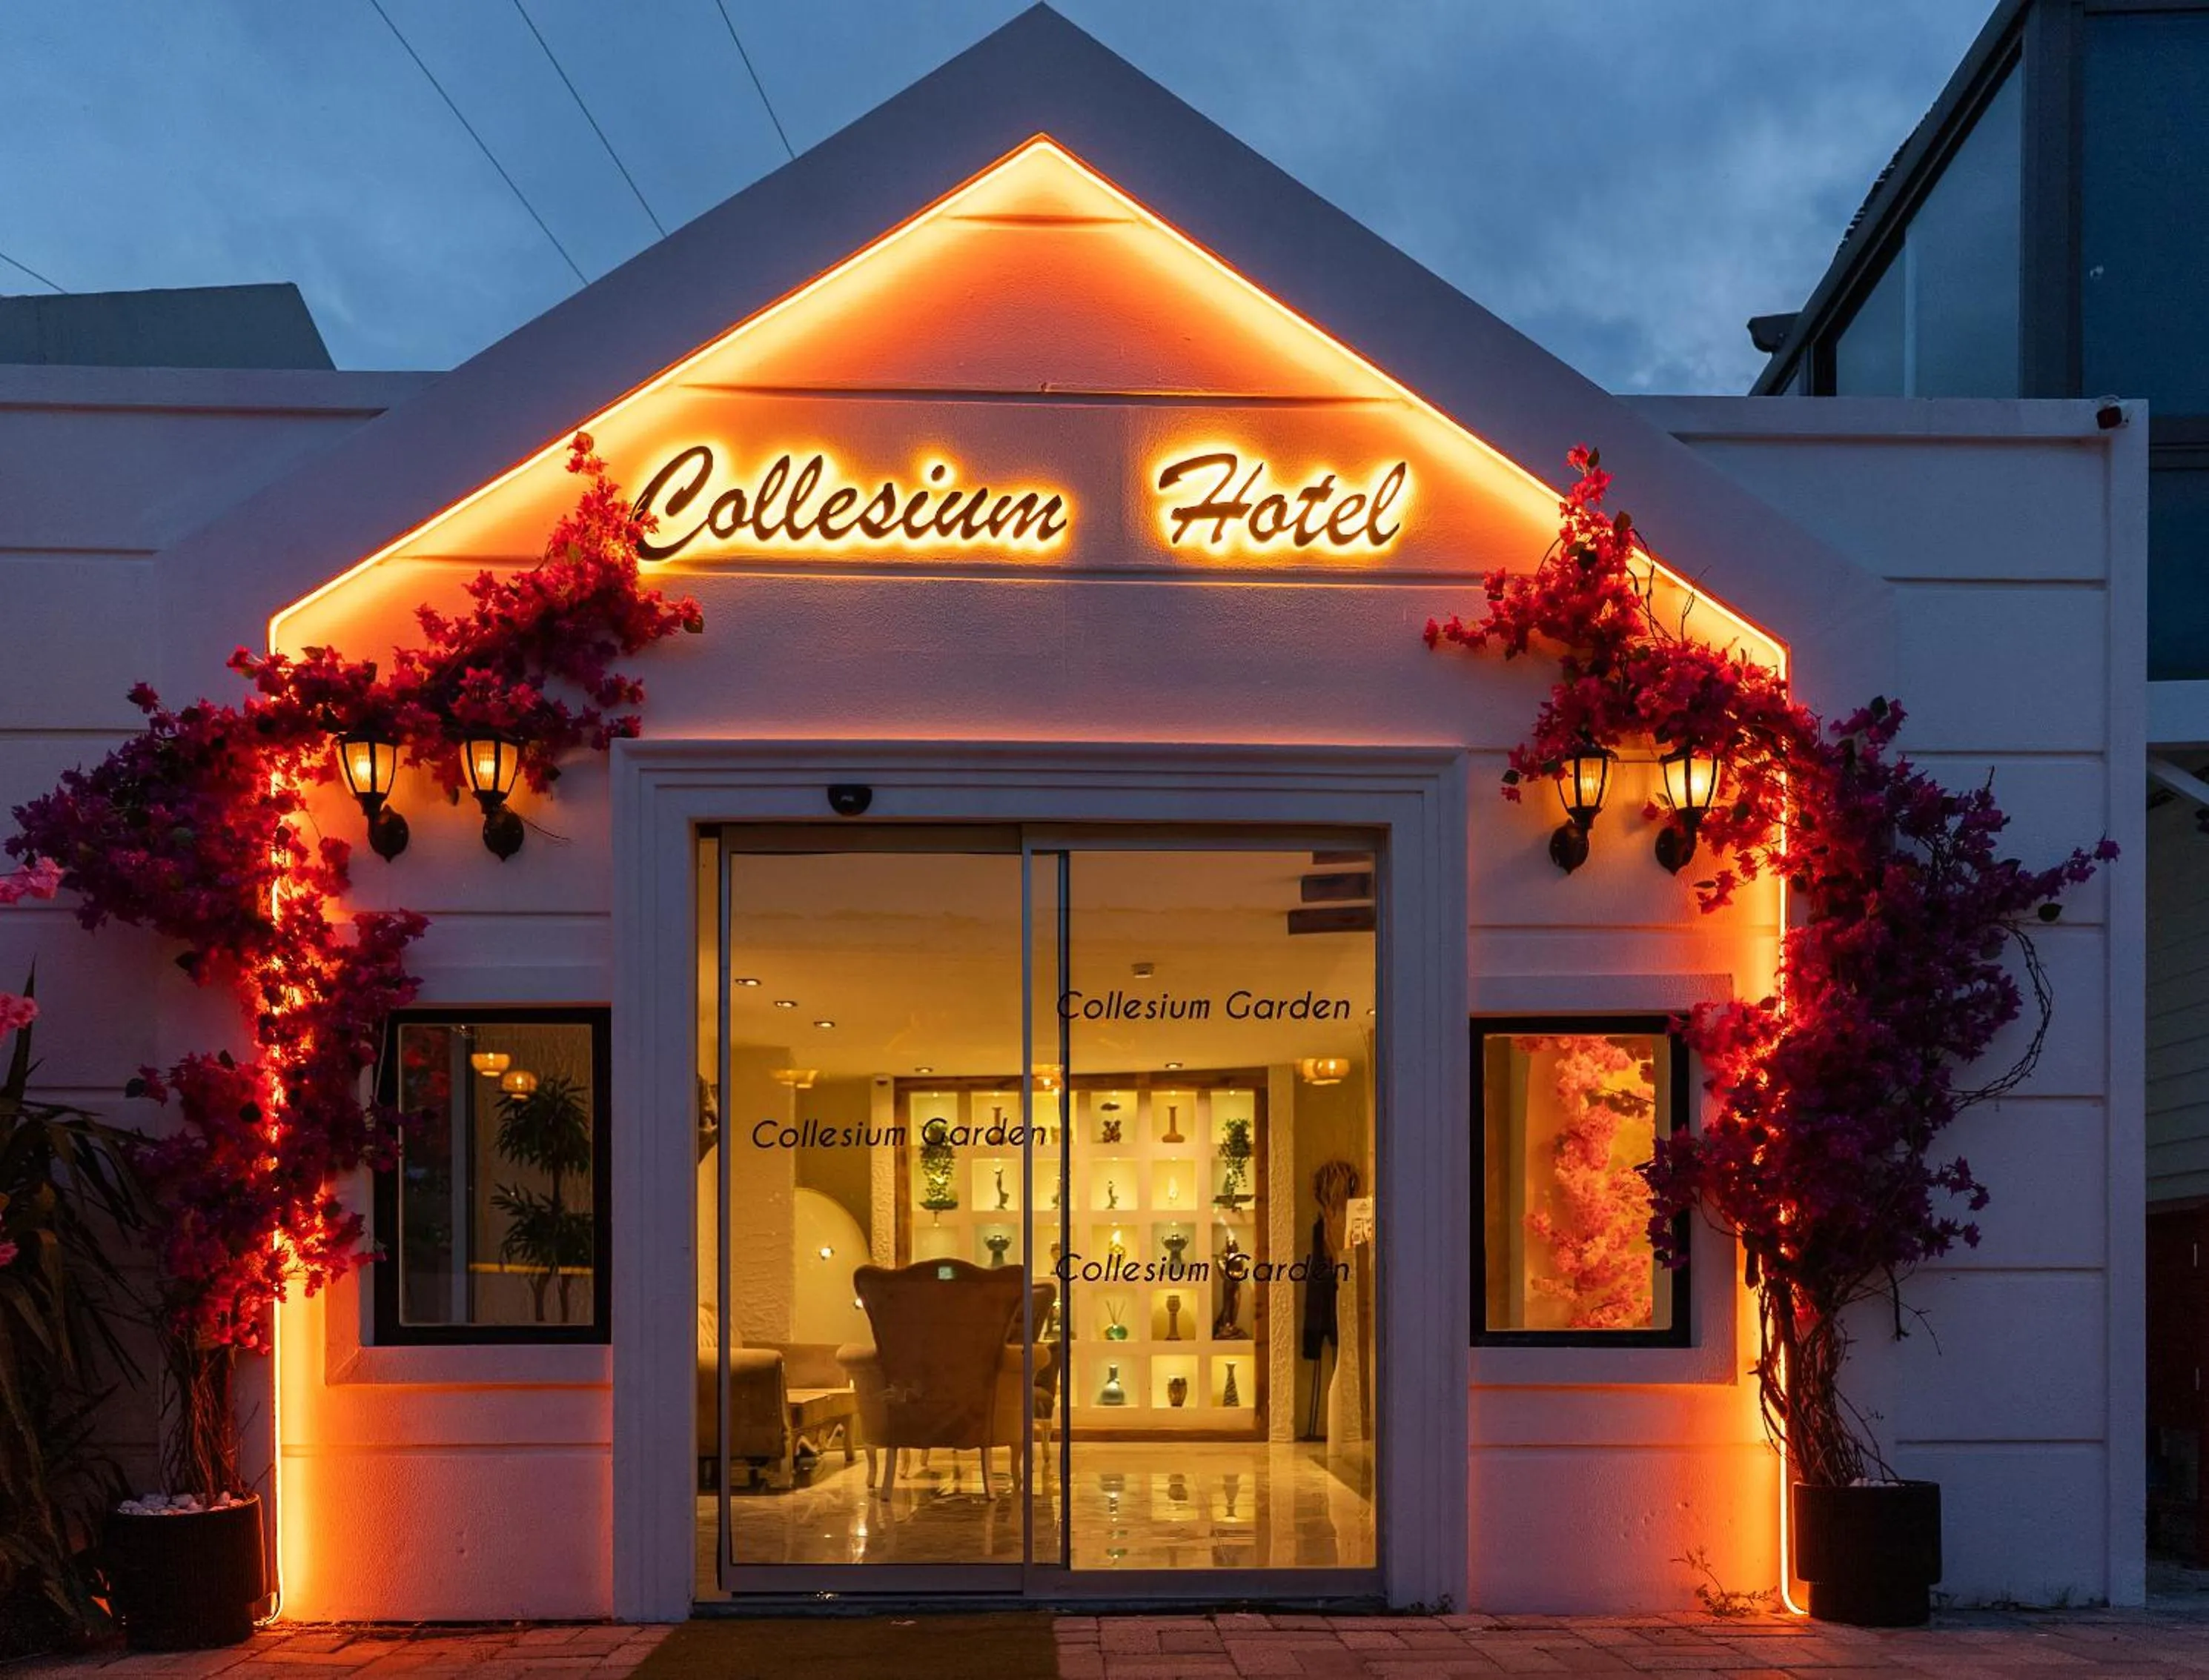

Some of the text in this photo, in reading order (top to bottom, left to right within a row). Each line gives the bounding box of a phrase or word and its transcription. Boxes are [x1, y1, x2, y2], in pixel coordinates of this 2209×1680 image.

[632, 445, 1406, 561] Collesium Hotel
[1057, 990, 1351, 1020] Collesium Garden
[752, 1117, 1046, 1149] Collesium Garden
[1056, 1252, 1209, 1282] Collesium
